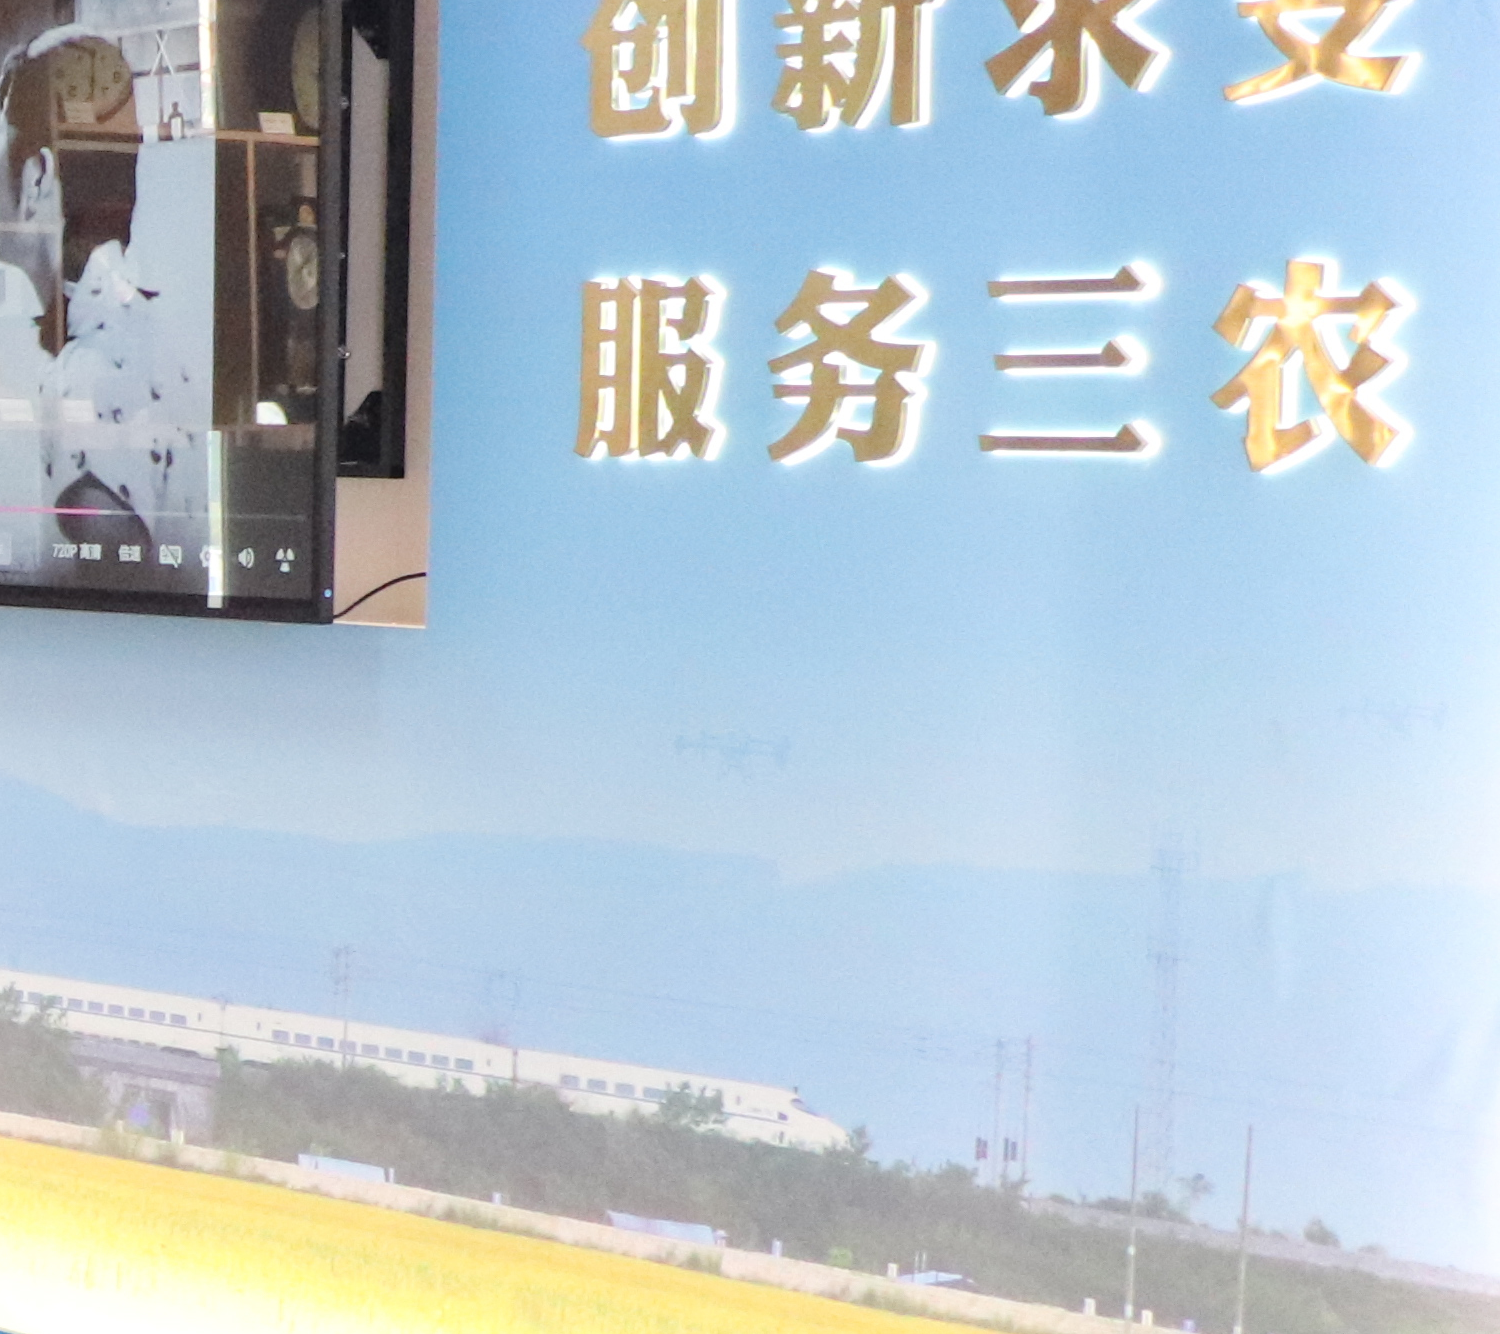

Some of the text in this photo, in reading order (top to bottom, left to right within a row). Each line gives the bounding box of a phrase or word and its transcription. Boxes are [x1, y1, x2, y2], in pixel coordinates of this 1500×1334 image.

[575, 257, 1415, 473] 服务三农
[52, 544, 77, 558] 720P
